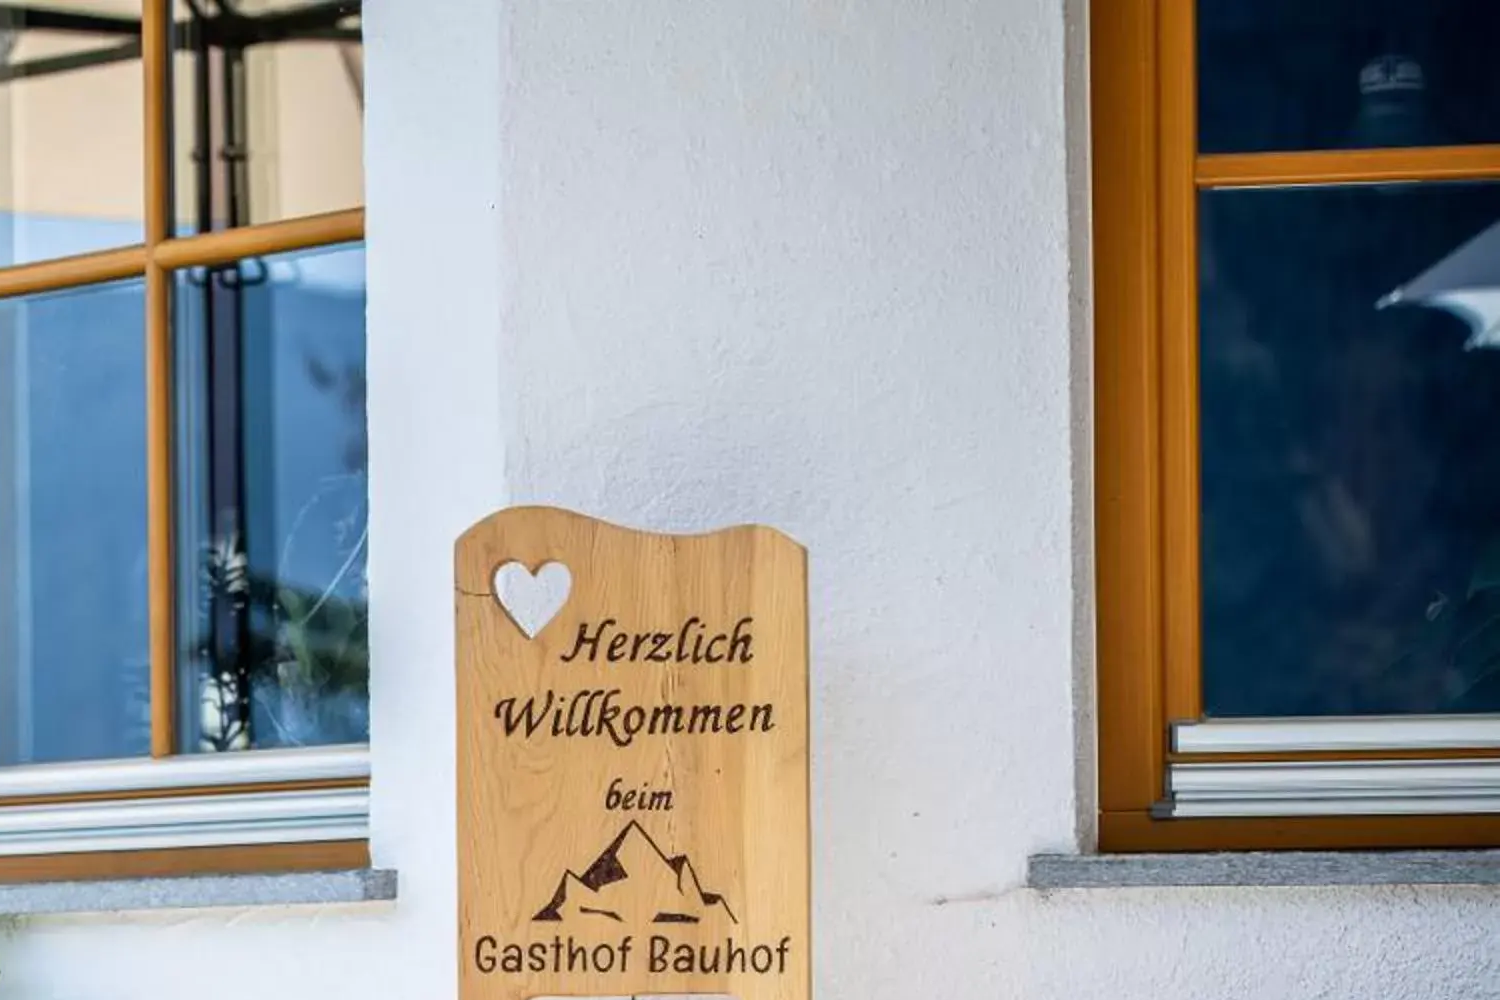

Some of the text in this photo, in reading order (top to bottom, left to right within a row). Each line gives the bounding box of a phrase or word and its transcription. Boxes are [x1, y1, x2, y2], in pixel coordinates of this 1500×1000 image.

[560, 616, 755, 664] Herzlich
[494, 689, 775, 747] Willkommen
[604, 777, 674, 810] beim
[475, 935, 791, 973] Gasthof Bauhof
